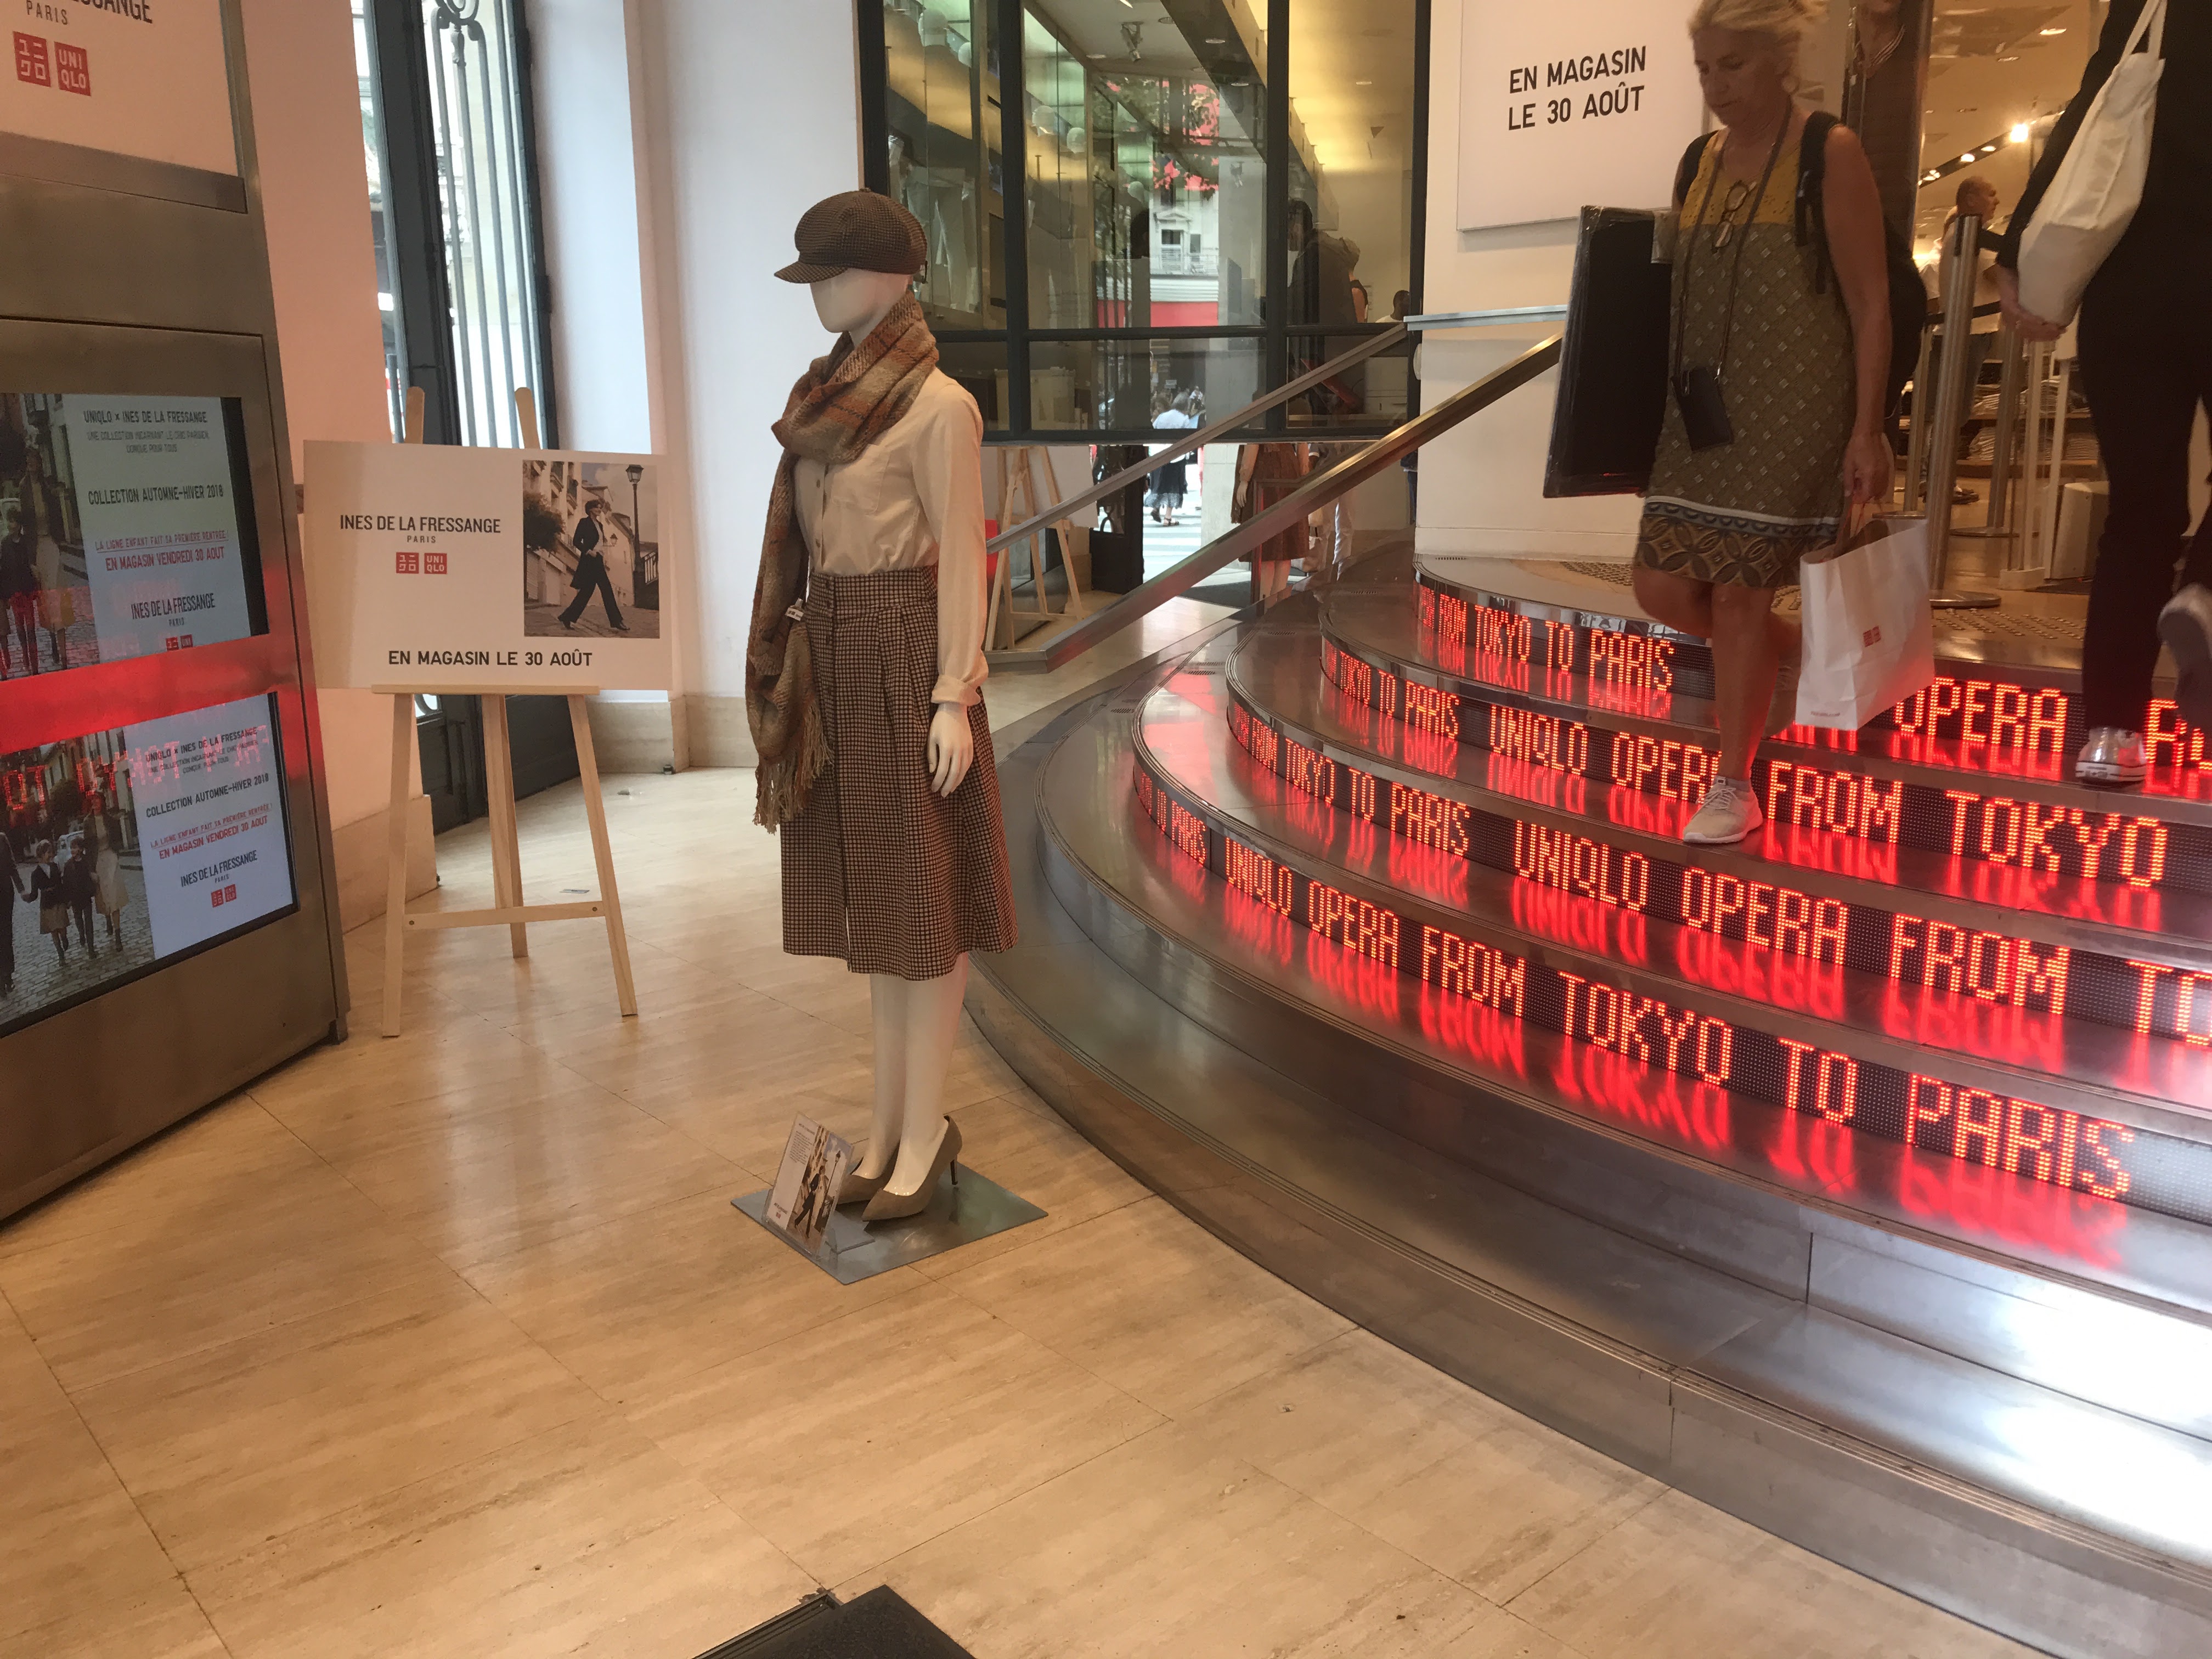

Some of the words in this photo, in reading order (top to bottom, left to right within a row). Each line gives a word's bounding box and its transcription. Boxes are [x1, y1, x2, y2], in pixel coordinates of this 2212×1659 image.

[26, 0, 68, 25] PARIS
[1510, 66, 1537, 93] EN
[1547, 46, 1646, 87] MAGASIN
[1509, 103, 1536, 130] LE
[1547, 98, 1571, 124] 30
[1582, 82, 1645, 119] AOÛT
[83, 410, 112, 424] UNIQLO
[122, 411, 139, 423] INES
[142, 411, 152, 422] DE
[154, 411, 165, 422] LA
[167, 411, 207, 423] FRESSANGE
[88, 488, 139, 505] COLLECTION
[143, 485, 205, 502] AUTOMNE-HIVER
[340, 515, 373, 531] INES
[377, 516, 394, 531] DE
[399, 516, 416, 532] LA
[420, 517, 501, 533] FRESSANGE
[95, 541, 104, 550] LA
[106, 539, 123, 549] LIGNE
[126, 537, 148, 548] ENFANT
[150, 535, 162, 545] FAIT
[407, 535, 436, 544] PARIS
[105, 557, 118, 571] EN
[119, 553, 154, 569] MAGASIN
[156, 549, 193, 565] VENDREDI
[195, 548, 204, 561] 30
[131, 601, 150, 619] INES
[151, 600, 161, 616] DE
[162, 599, 172, 615] LA
[173, 592, 216, 614] FRESSANGE
[388, 651, 410, 665] EN
[417, 651, 489, 665] MAGASIN
[497, 651, 518, 665] LE
[524, 652, 543, 665] 30
[550, 648, 592, 666] AOÛT
[1475, 604, 1531, 662] TOKYO
[1545, 620, 1575, 671] TO
[1590, 629, 1676, 691] PARIS
[1894, 676, 2068, 753] OPERA
[180, 742, 196, 754] INES
[198, 740, 207, 748] DE
[209, 737, 219, 746] LA
[221, 726, 257, 743] FRESSANGE
[1378, 669, 1395, 715] TO
[1404, 680, 1460, 740] PARIS
[1490, 704, 1588, 776] UNIQLO
[1768, 760, 1903, 844] FROM
[1945, 789, 2168, 888] TOKYO
[146, 795, 193, 818] COLLECTION
[195, 778, 252, 804] AUTOMNE-HIVER
[254, 772, 269, 785] 2018
[150, 840, 159, 848] LA
[160, 833, 176, 844] LIGNE
[178, 826, 199, 839] ENFANT
[200, 822, 212, 832] FAIT
[159, 848, 170, 860] EN
[172, 836, 204, 856] MAGASIN
[206, 825, 239, 843] VENDREDI
[241, 821, 249, 832] 30
[180, 871, 198, 887] INES
[199, 867, 208, 881] DE
[209, 864, 218, 877] LA
[219, 850, 257, 873] FRESSANGE
[1285, 738, 1335, 804] TOKYO
[1348, 767, 1375, 822] TO
[1390, 782, 1470, 857] PARIS
[1514, 820, 1650, 912] UNIQLO
[1681, 866, 1849, 966] OPERA
[1889, 913, 2070, 1015] FROM
[1171, 800, 1206, 865] PARIS
[1225, 837, 1294, 917] UNIQLO
[1308, 881, 1400, 968] OPERA
[1421, 925, 1526, 1018] FROM
[1559, 970, 1733, 1086] TOKYO
[1778, 1037, 1859, 1125] TO
[1905, 1073, 2135, 1200] PARIS
